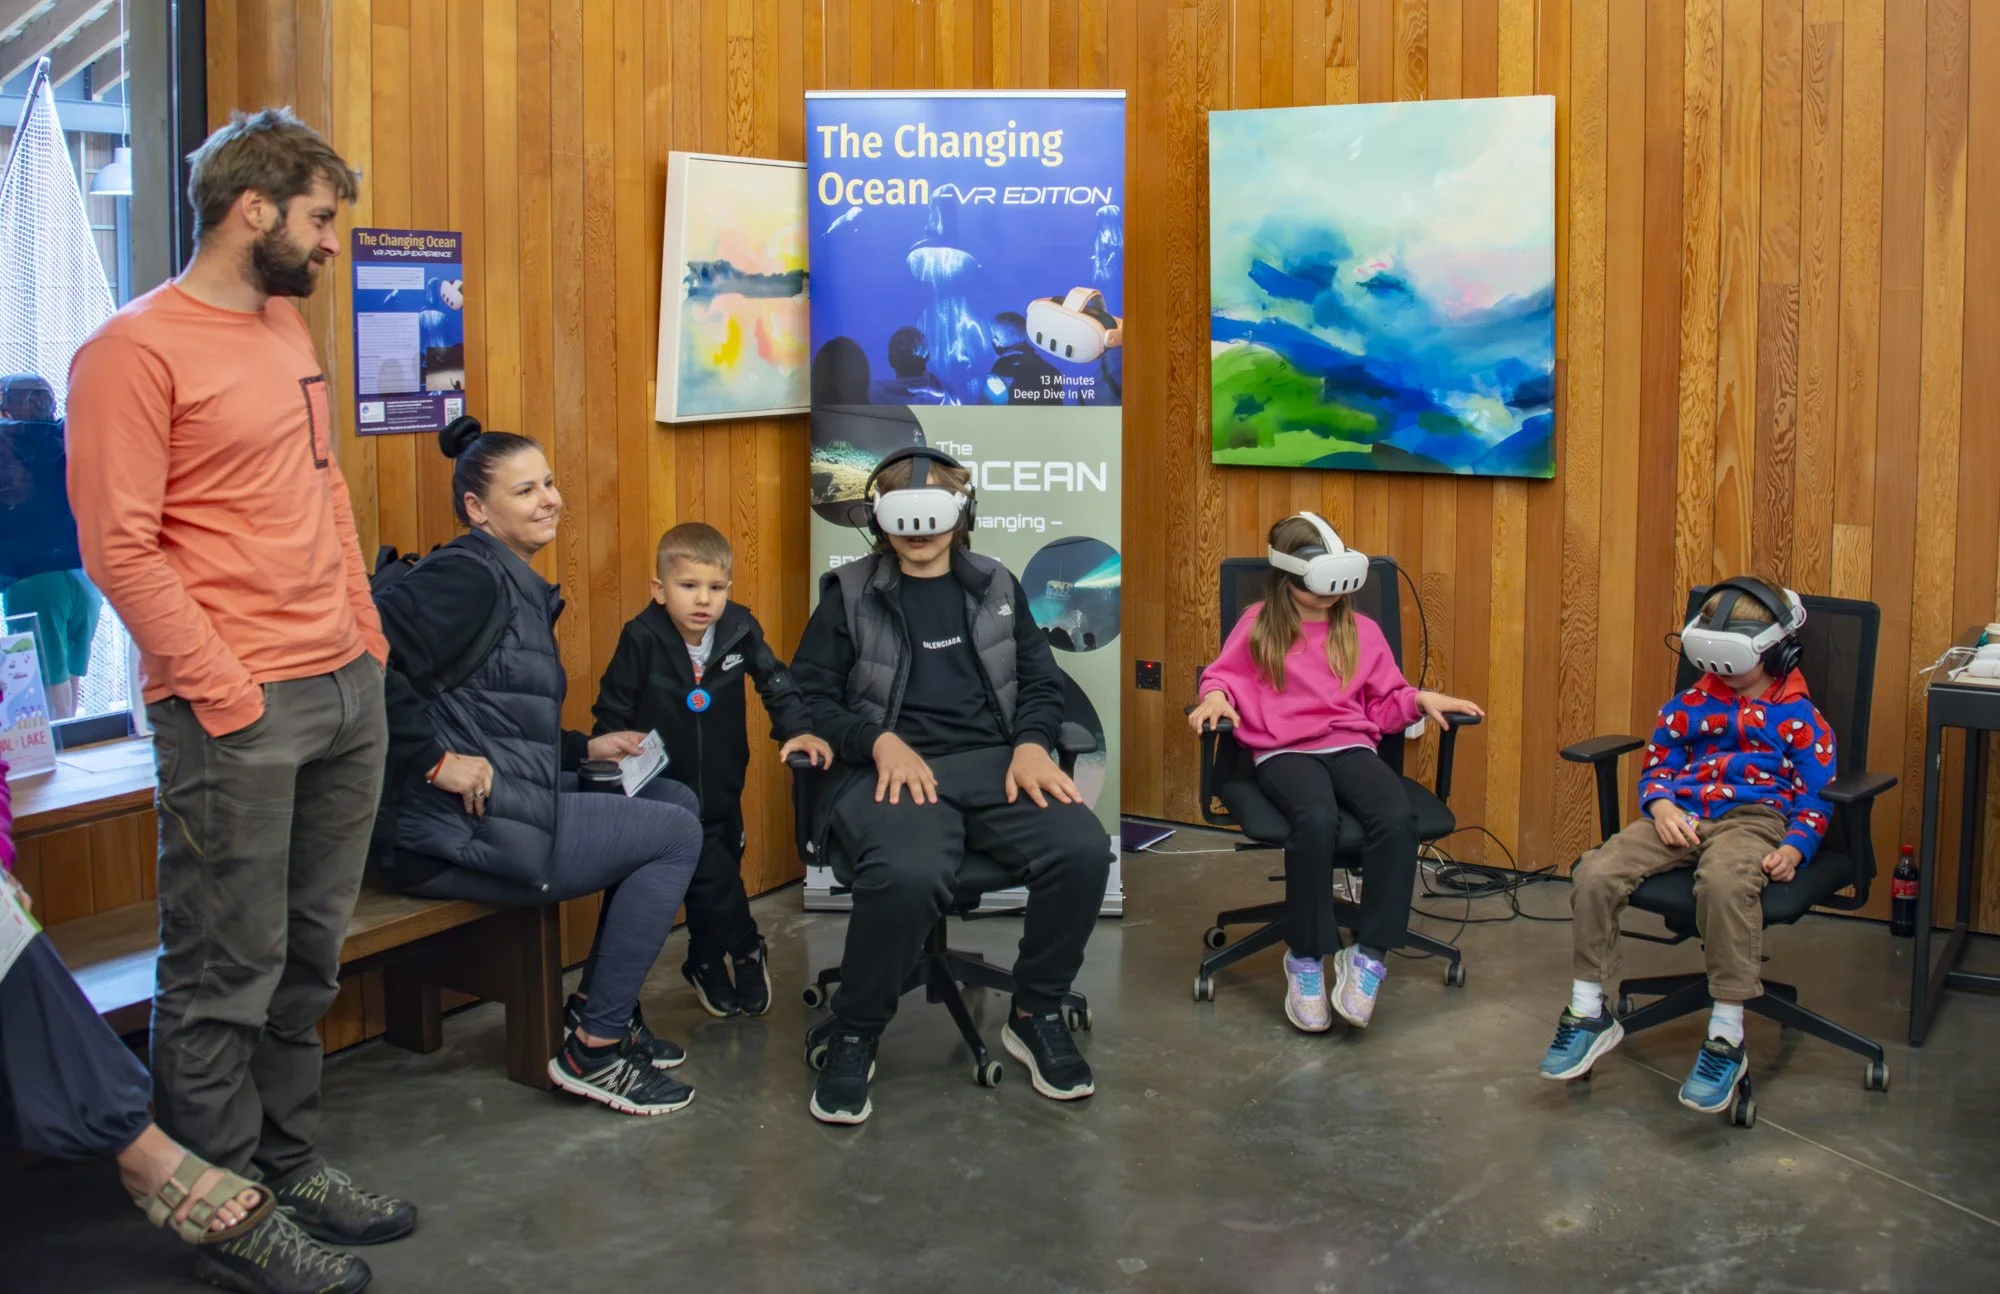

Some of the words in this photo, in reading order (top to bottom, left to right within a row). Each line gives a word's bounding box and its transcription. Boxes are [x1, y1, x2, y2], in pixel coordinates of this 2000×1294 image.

[817, 123, 883, 158] The
[894, 120, 1064, 167] Changing
[818, 172, 929, 206] Ocean
[1003, 186, 1113, 205] EDITION
[358, 232, 377, 246] The
[378, 233, 425, 250] Changing
[426, 235, 456, 248] Ocean
[411, 250, 452, 258] EXPERIENCE
[1040, 375, 1051, 386] 13
[1053, 374, 1096, 386] Minutes
[1013, 388, 1041, 401] Deep
[1043, 388, 1066, 399] Dive
[1068, 389, 1078, 399] In
[1081, 389, 1096, 399] VR
[935, 440, 973, 456] The
[974, 513, 1046, 532] anging
[829, 552, 868, 569] an
[726, 654, 742, 663] NIKE
[20, 730, 47, 749] LAKE
